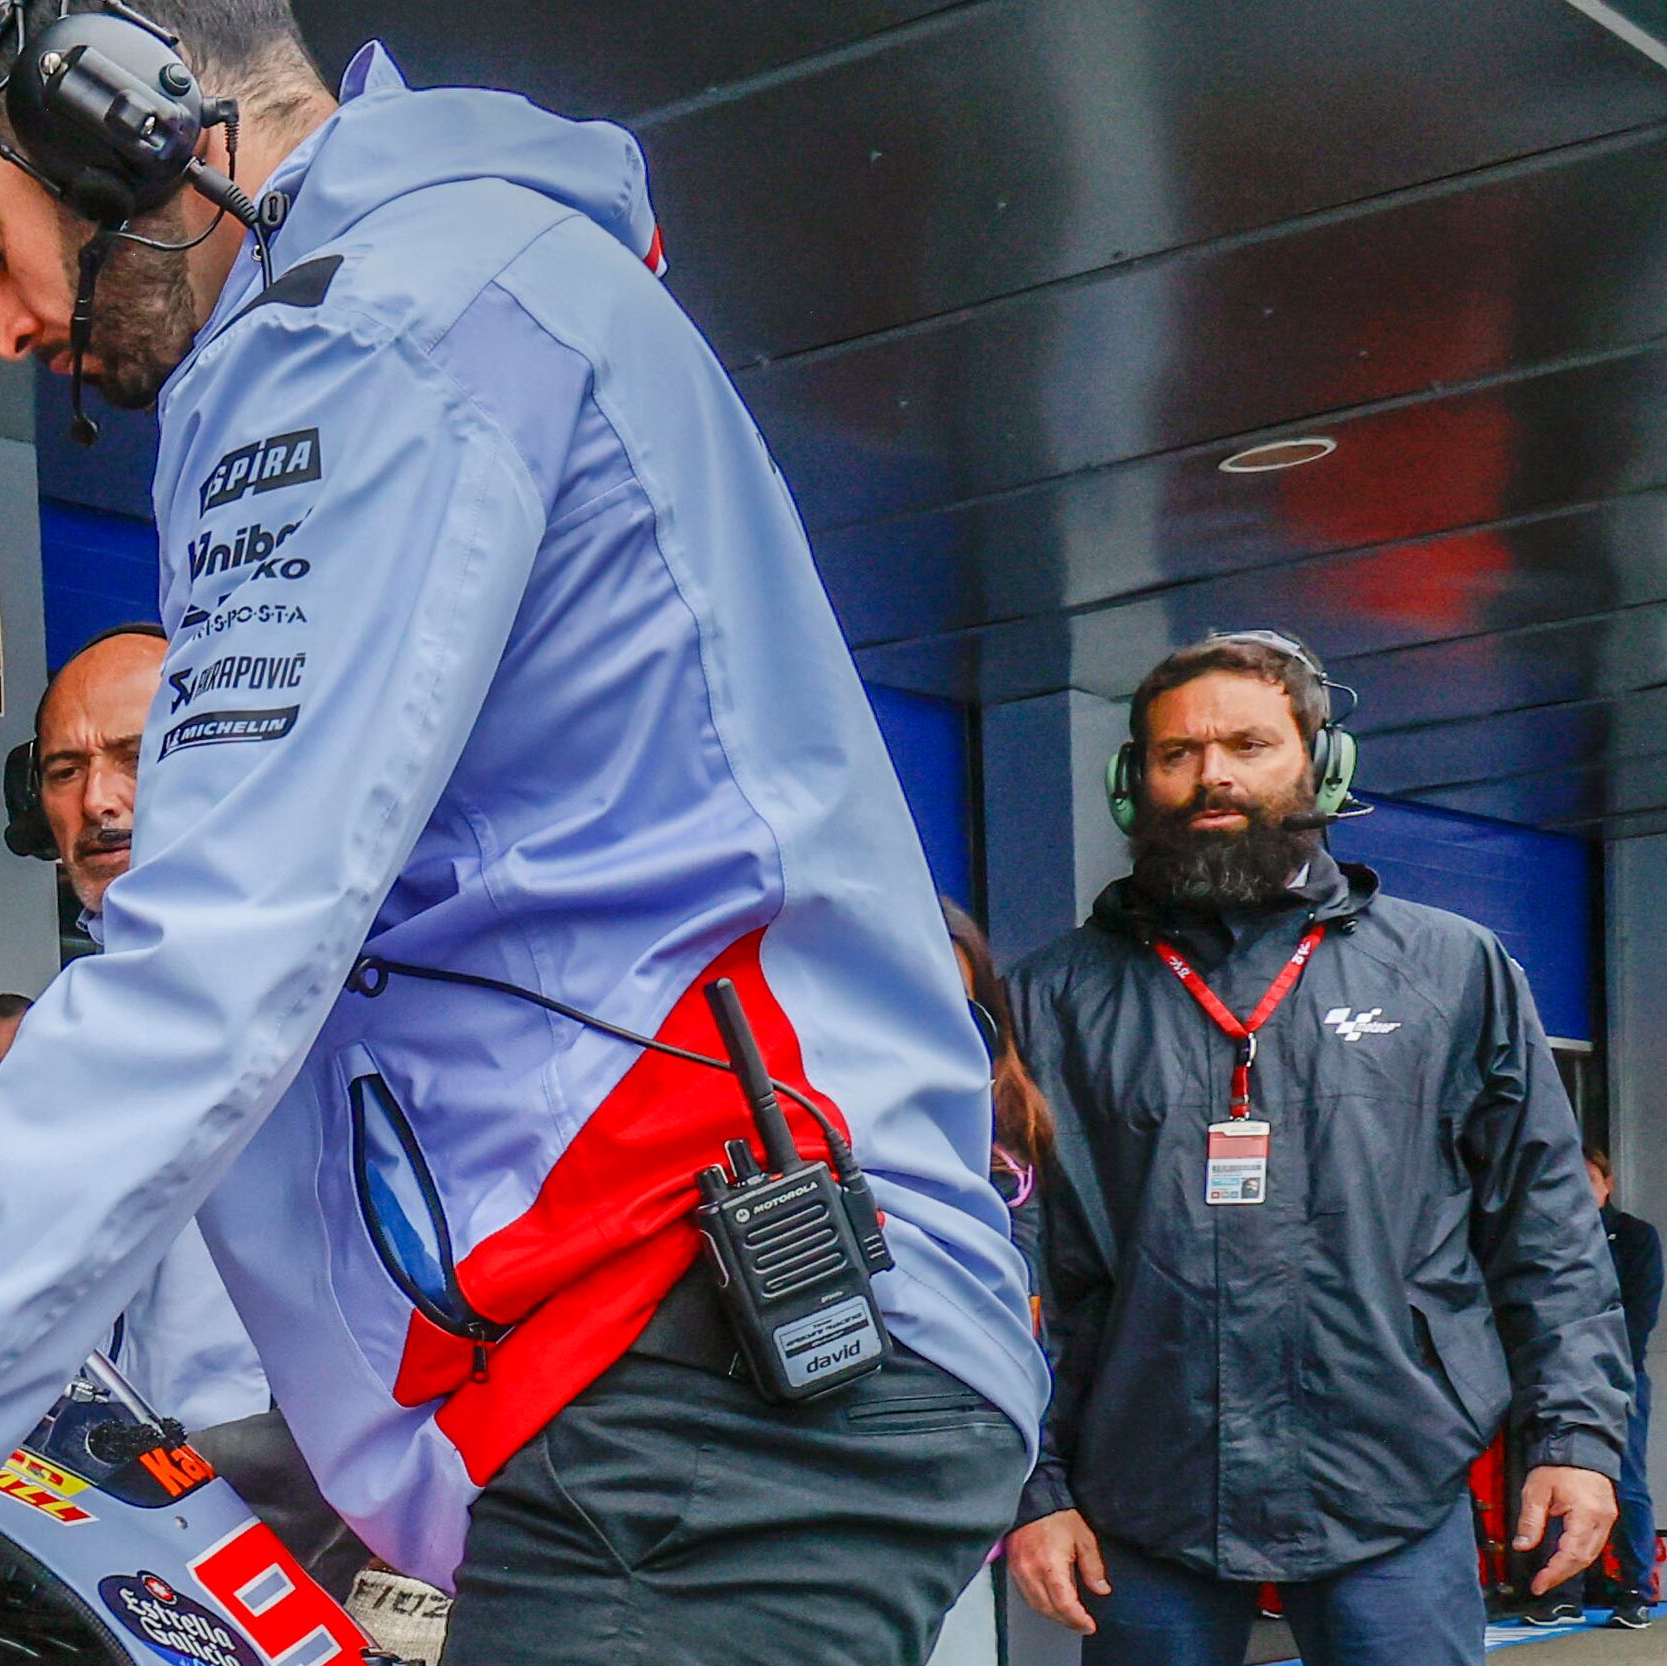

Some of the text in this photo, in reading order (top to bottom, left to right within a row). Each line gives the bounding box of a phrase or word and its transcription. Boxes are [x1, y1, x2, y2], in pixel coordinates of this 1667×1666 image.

[179, 716, 287, 742] MICHELIN
[752, 1181, 818, 1216] MOTOROLA
[805, 1339, 862, 1374] david
[138, 1444, 216, 1498] Ka
[118, 1587, 237, 1651] Estrella
